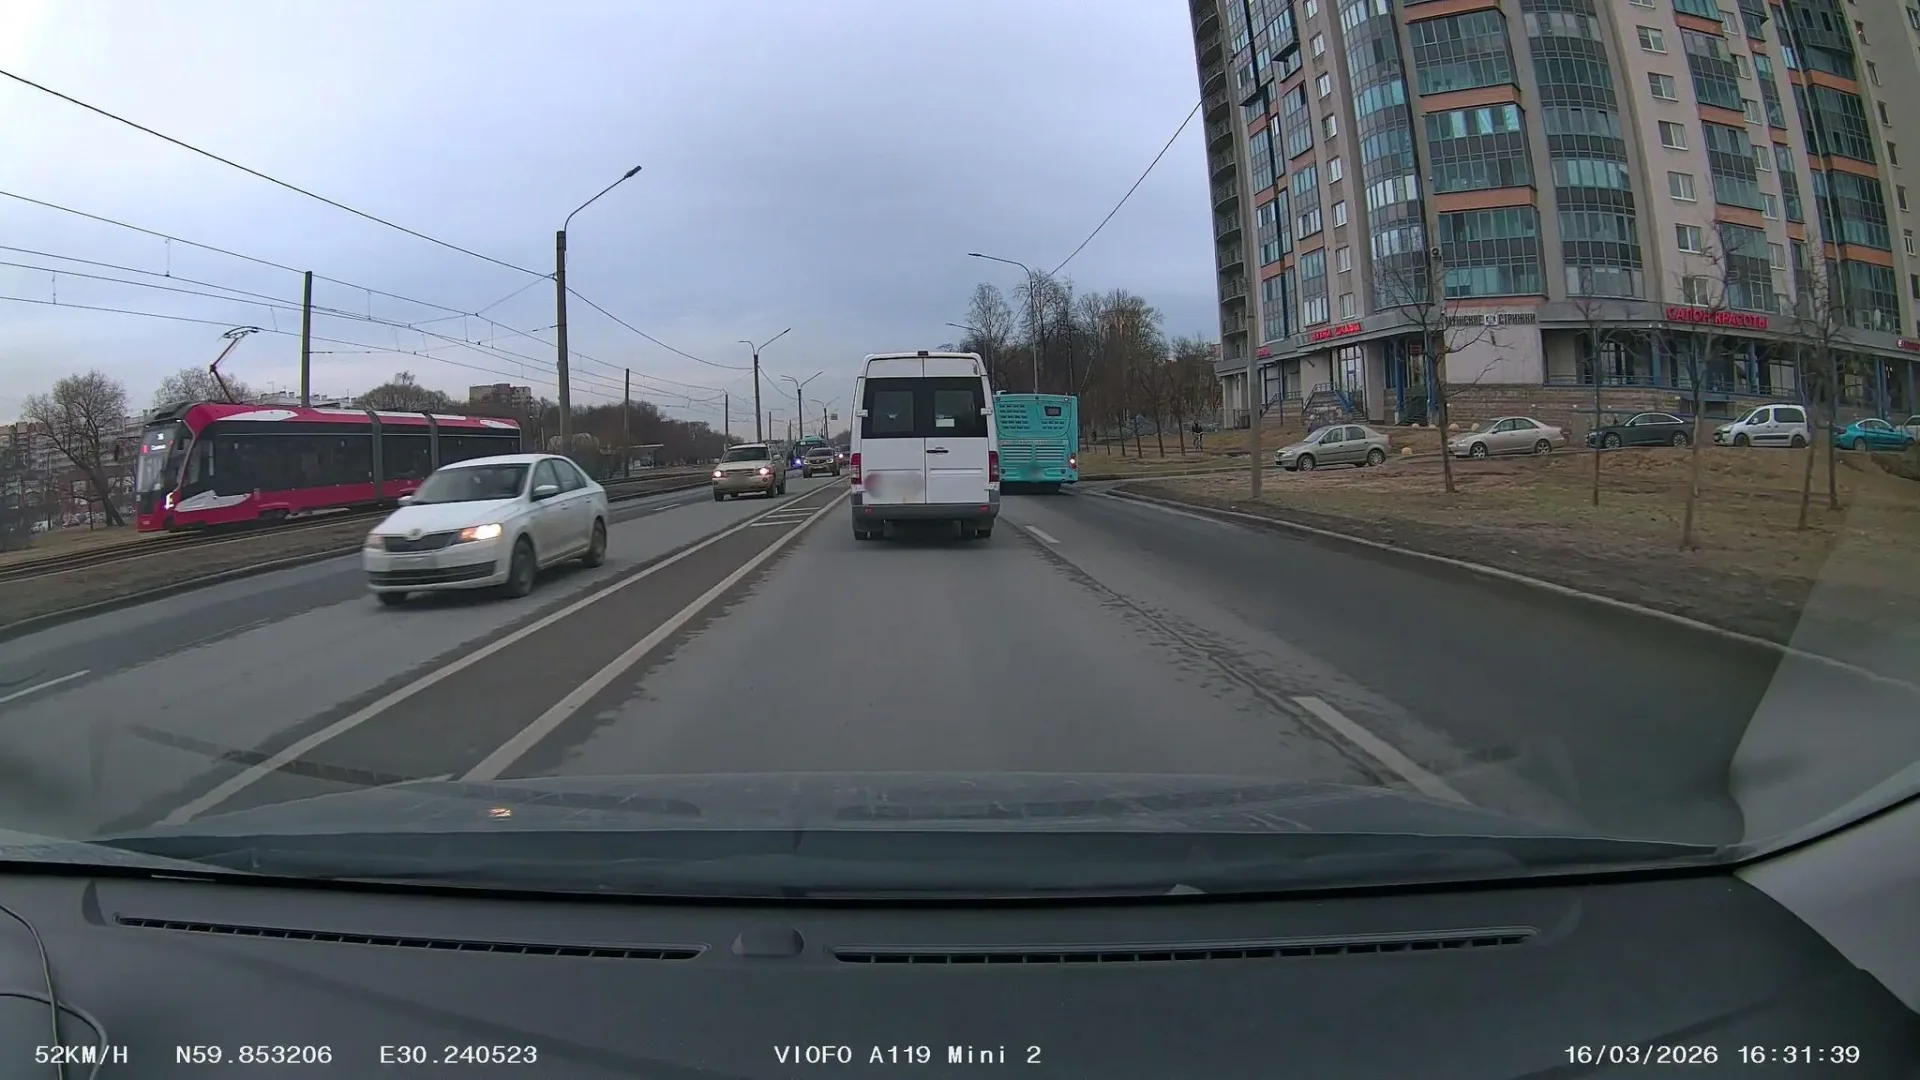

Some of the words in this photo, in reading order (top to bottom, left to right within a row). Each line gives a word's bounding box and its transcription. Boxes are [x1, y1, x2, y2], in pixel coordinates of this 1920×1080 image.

[1497, 312, 1536, 326] СТРИЖКИ
[1666, 306, 1711, 323] САЛОН
[1714, 311, 1769, 329] КРАСОТЫ
